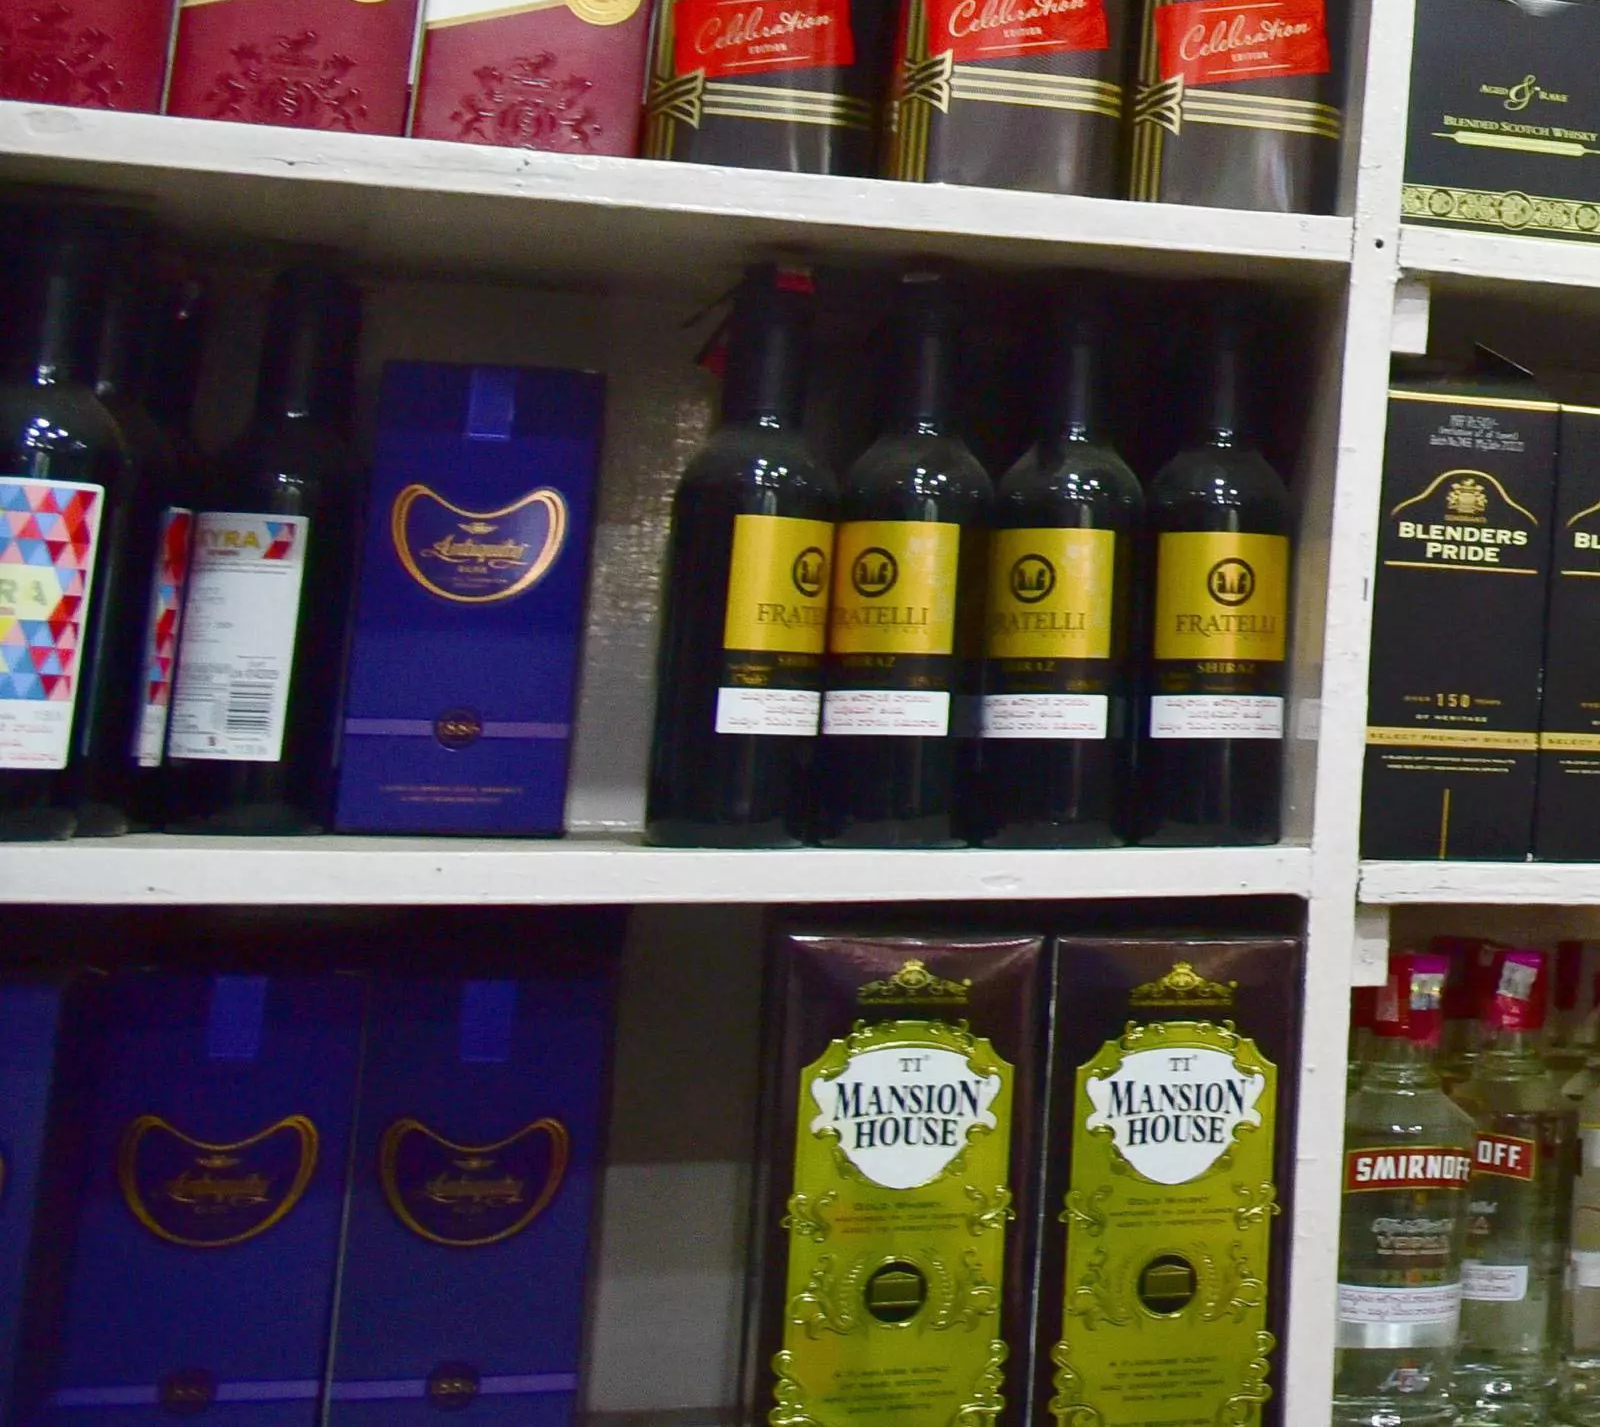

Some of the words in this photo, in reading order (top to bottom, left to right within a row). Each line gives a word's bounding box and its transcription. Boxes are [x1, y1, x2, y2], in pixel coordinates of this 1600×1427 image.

[694, 4, 832, 54] Celebration
[1179, 14, 1311, 63] Celebration
[1443, 115, 1498, 133] BLENDED
[1500, 121, 1549, 137] SCOTCH
[1551, 127, 1598, 142] WHISKY
[1398, 521, 1528, 546] BLENDERS
[1425, 542, 1500, 563] PRIDE
[1176, 614, 1277, 637] FRATELLI
[1436, 693, 1471, 709] 150
[834, 1079, 981, 1120] MANSION
[1107, 1078, 1246, 1119] MANSION
[854, 1116, 959, 1150] HOUSE
[1127, 1116, 1225, 1146] HOUSE
[1356, 1154, 1471, 1183] SMIRNOFF
